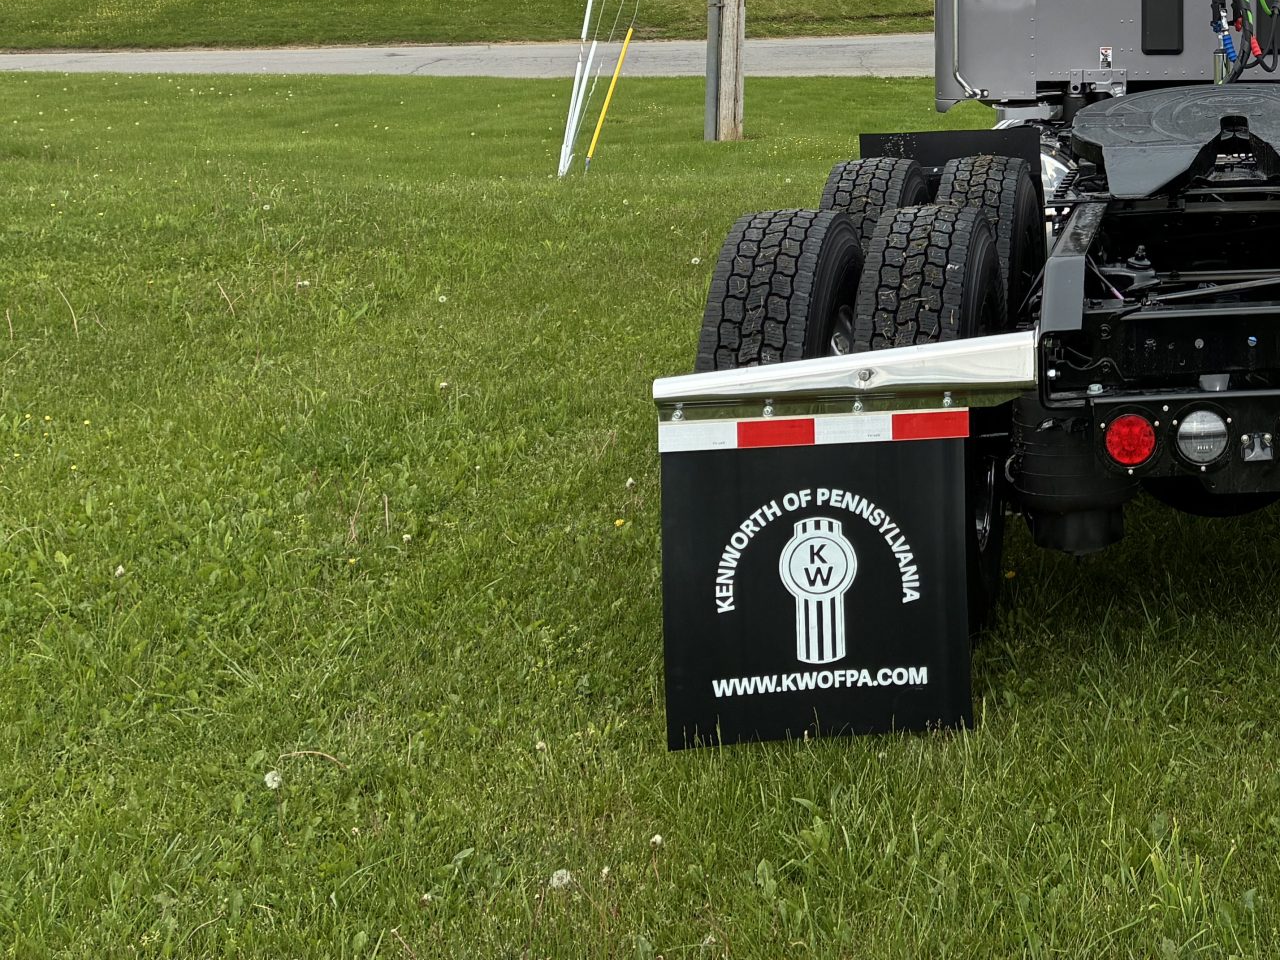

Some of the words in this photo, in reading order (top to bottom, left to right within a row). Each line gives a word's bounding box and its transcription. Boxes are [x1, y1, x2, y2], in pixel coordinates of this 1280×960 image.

[715, 500, 783, 614] KENWORTH
[782, 488, 812, 512] OF
[816, 487, 921, 604] PENNSYLVANIA
[809, 544, 828, 565] K
[803, 566, 835, 587] W
[712, 666, 928, 698] WWW.KWOFPA.COM
